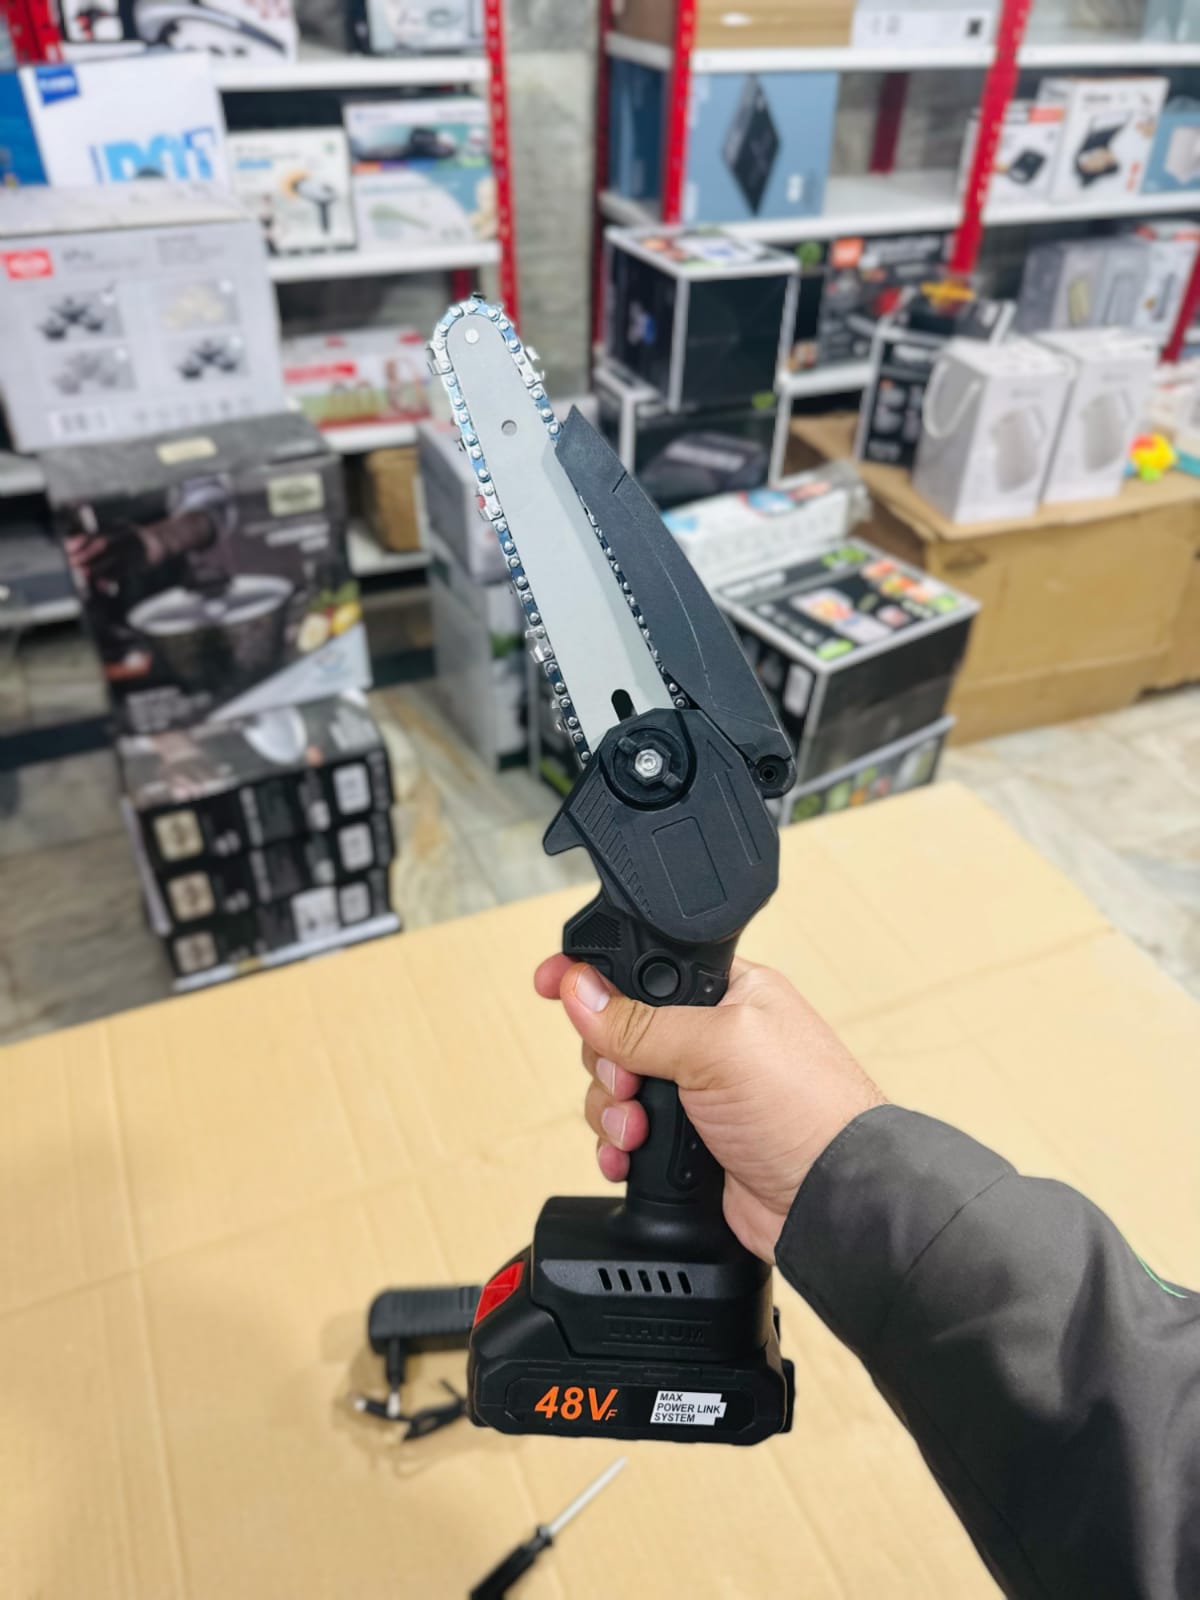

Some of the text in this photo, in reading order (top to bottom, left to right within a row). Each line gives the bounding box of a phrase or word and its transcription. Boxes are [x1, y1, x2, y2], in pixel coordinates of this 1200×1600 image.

[660, 1393, 683, 1401] MAX
[656, 1403, 721, 1414] POWER LINK
[654, 1413, 695, 1422] SYSTEM
